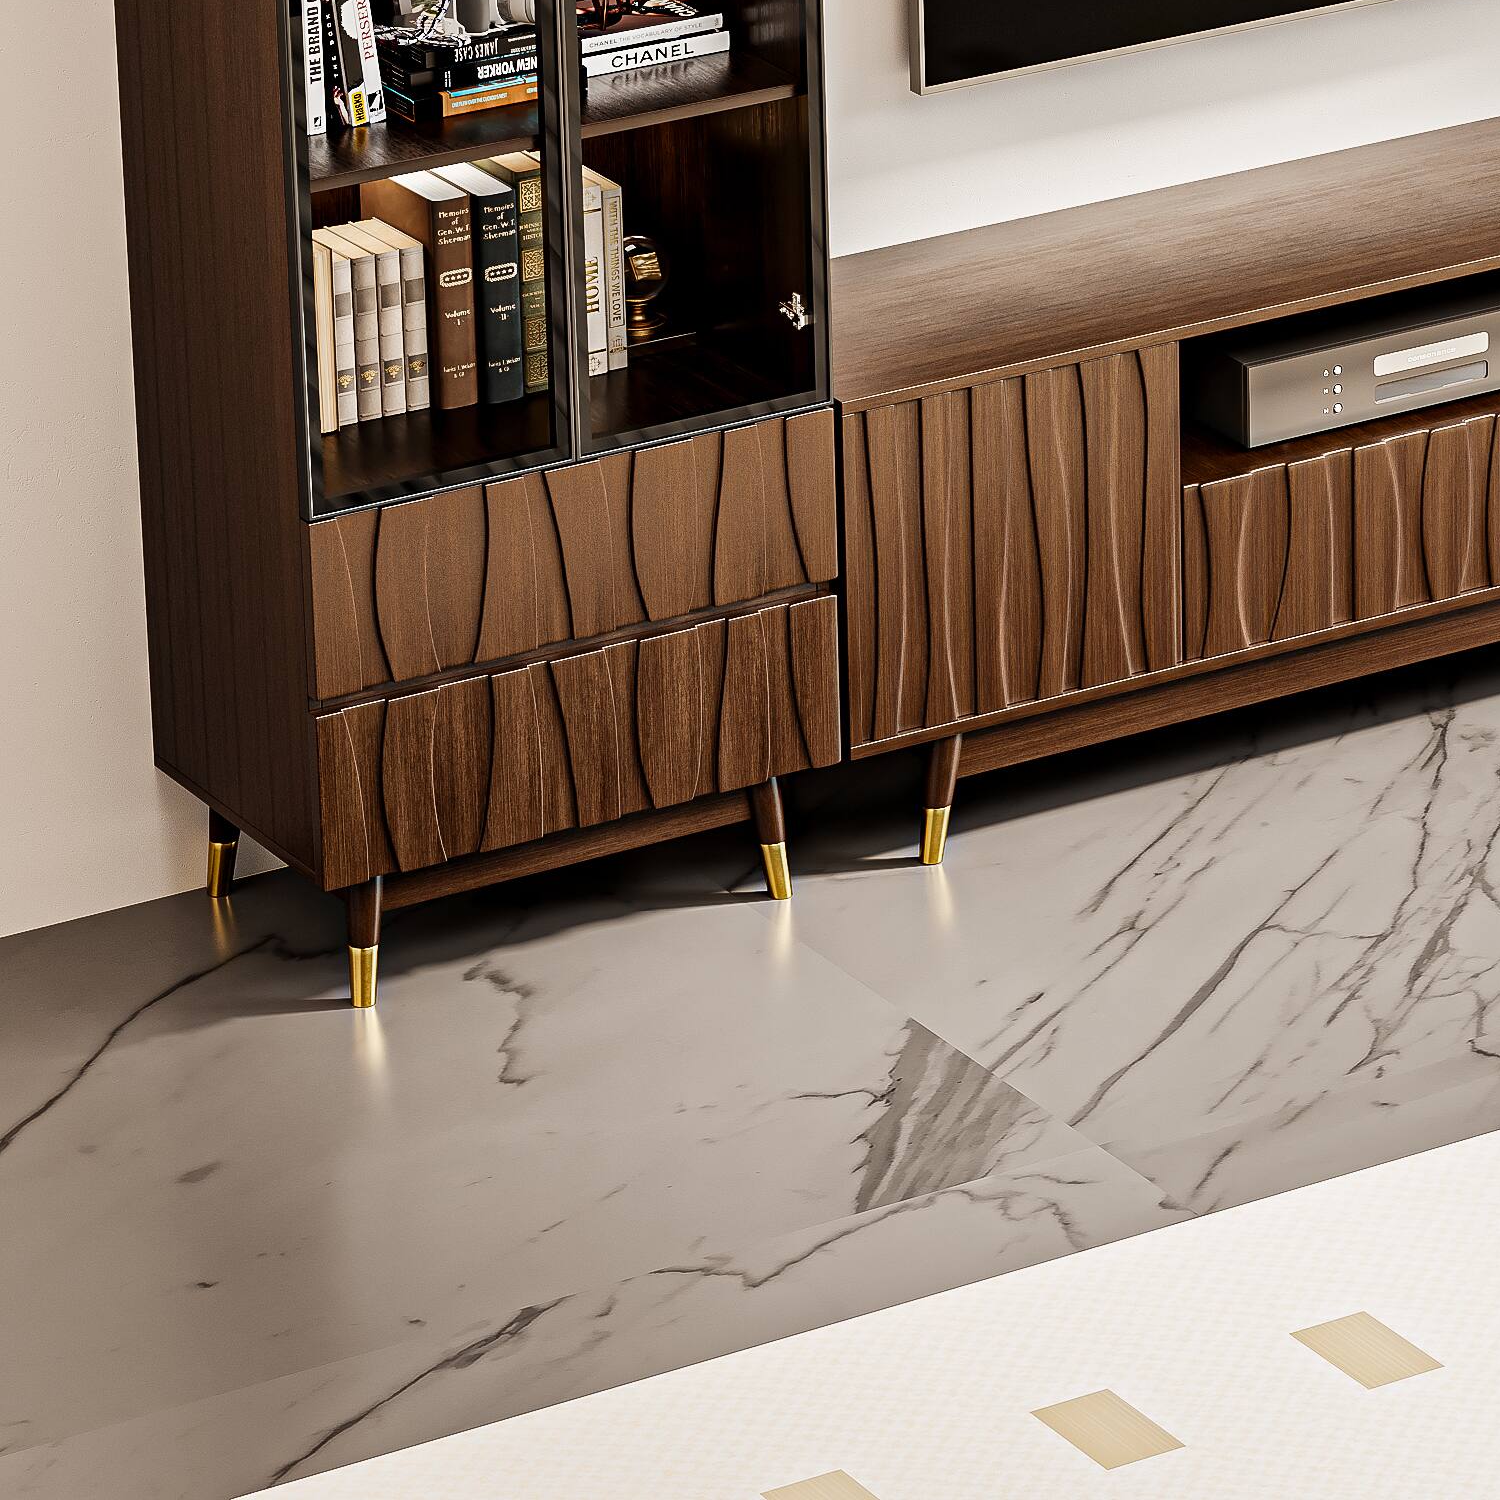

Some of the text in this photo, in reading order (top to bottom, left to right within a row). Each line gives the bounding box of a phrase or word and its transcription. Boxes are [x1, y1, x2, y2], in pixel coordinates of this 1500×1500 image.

[306, 6, 321, 56] BRAND
[475, 37, 499, 60] JAMES
[589, 37, 618, 49] CHANEL
[454, 44, 473, 62] CASE
[611, 42, 695, 68] CHANEL
[309, 56, 323, 85] THE
[477, 56, 538, 80] NEW YORKER
[438, 207, 469, 220] Memoirs
[483, 202, 515, 215] Memoirs
[451, 217, 460, 226] of
[496, 211, 504, 221] of
[437, 233, 471, 246] Sherman
[482, 228, 516, 241] Sherman
[609, 200, 622, 322] WITH THE THINGS WE LOVE
[444, 308, 471, 320] Volume
[489, 303, 516, 315] Volume
[1407, 347, 1457, 363] consonance
